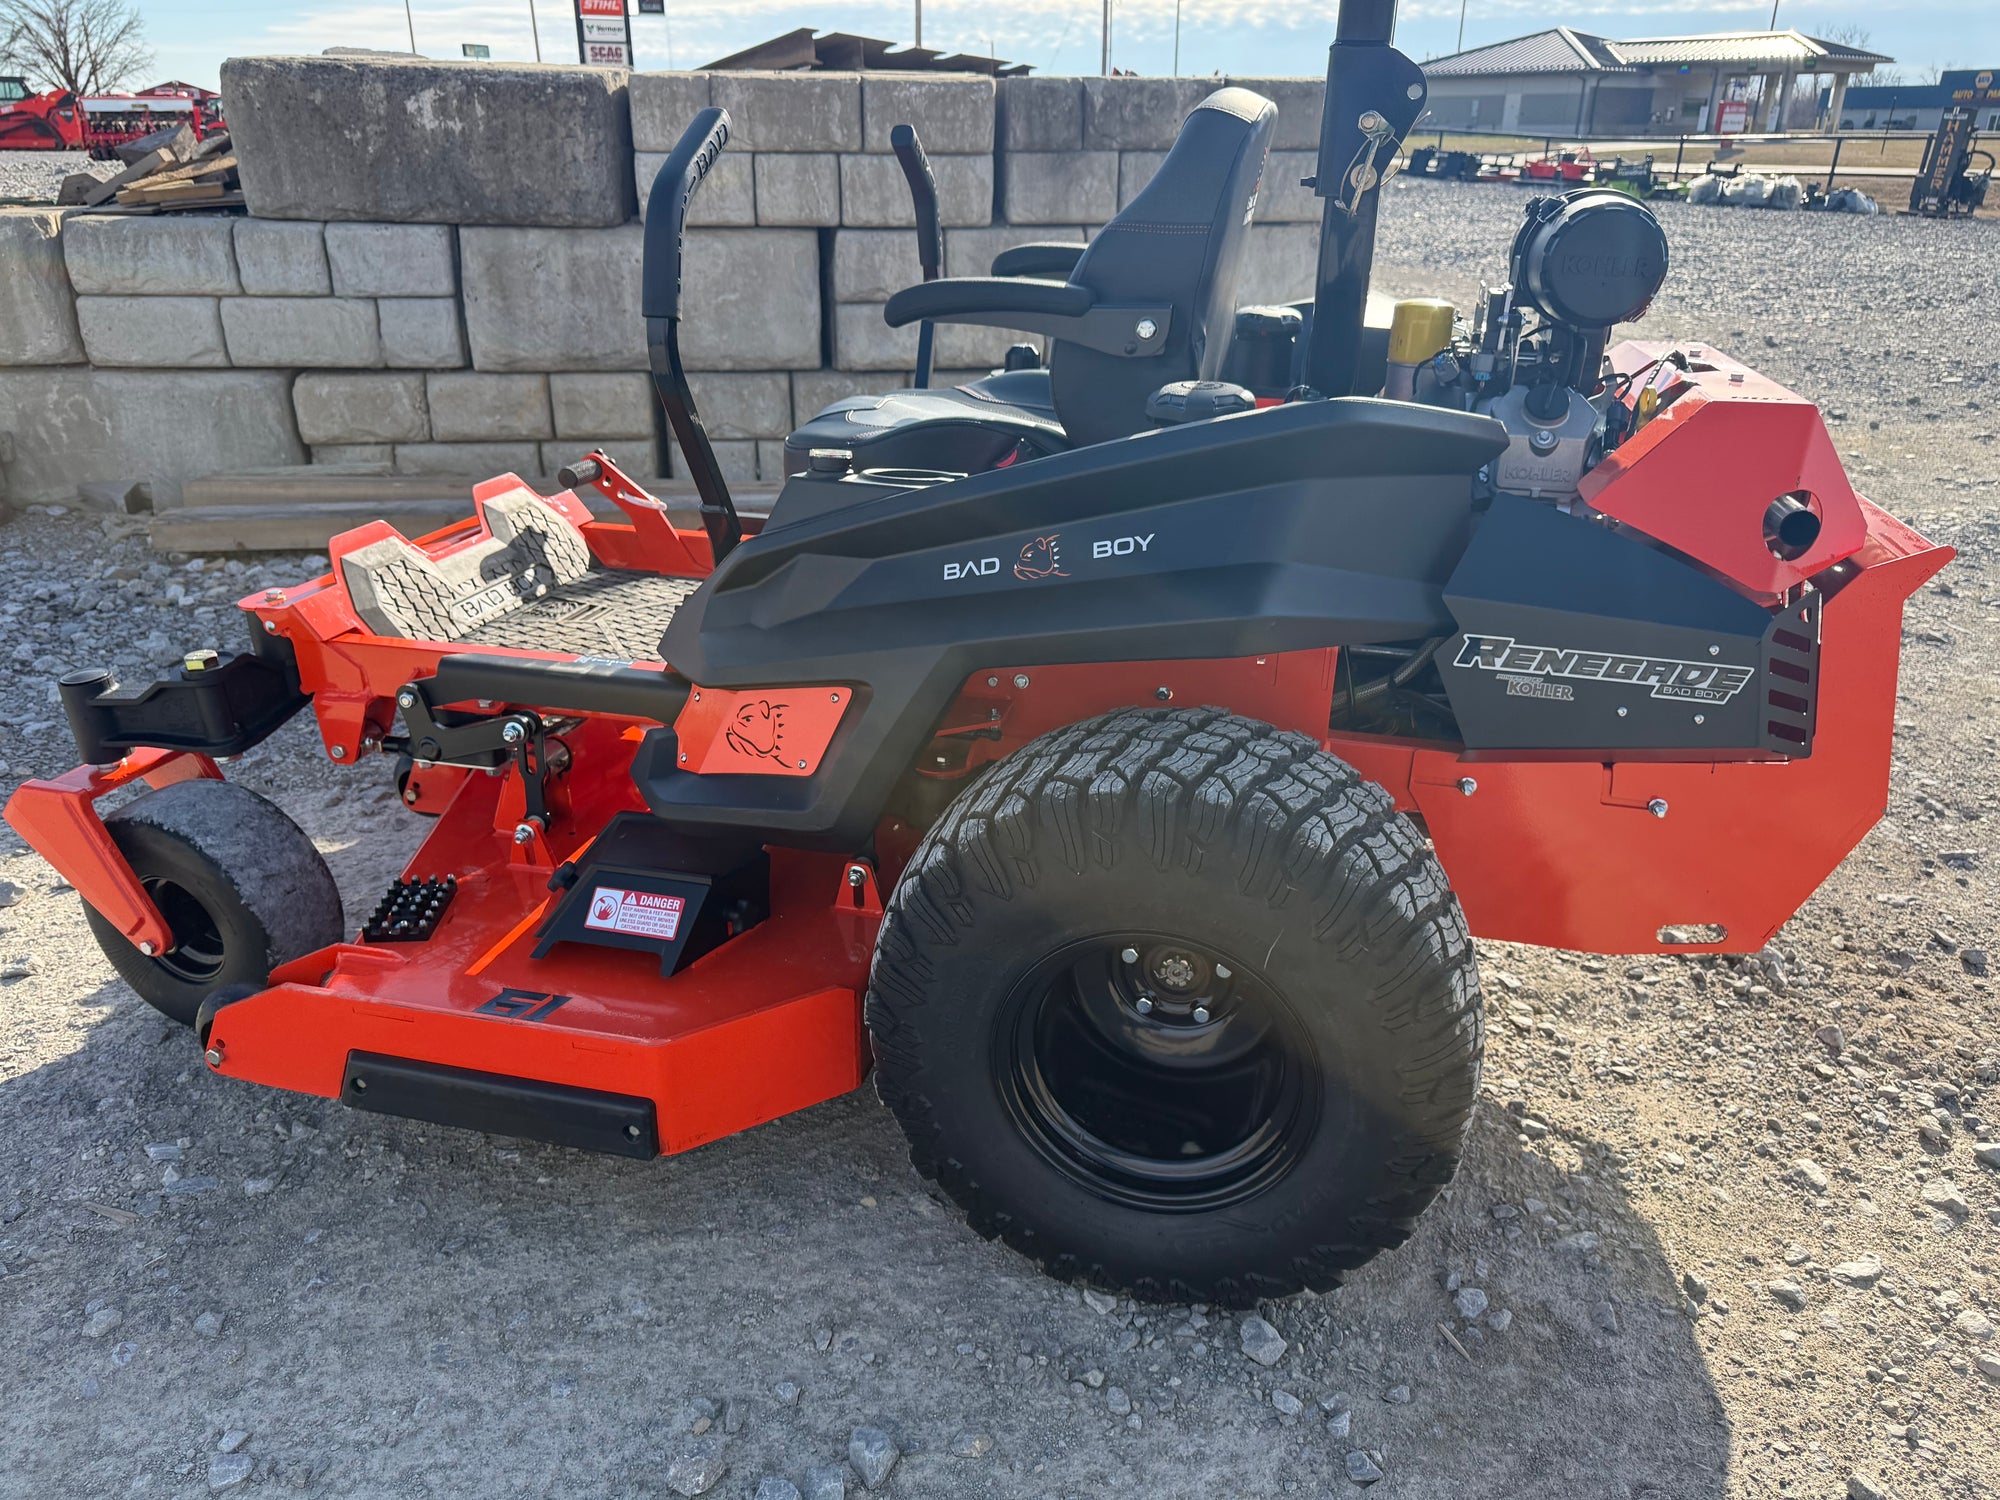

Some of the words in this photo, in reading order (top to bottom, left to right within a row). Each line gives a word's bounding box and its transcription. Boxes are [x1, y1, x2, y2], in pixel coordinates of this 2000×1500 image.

[583, 0, 620, 11] STIHL
[590, 46, 622, 58] SCAG
[1952, 90, 1974, 99] AUTO
[696, 123, 729, 181] BAD
[1930, 120, 1960, 190] HAMMER
[1561, 255, 1649, 277] KOHLER
[1504, 465, 1571, 482] KOHLER
[944, 557, 1000, 580] BAD
[1092, 533, 1155, 559] BOY
[459, 588, 505, 618] BAD
[1663, 686, 1691, 696] BAD
[1695, 690, 1725, 700] BOY
[640, 895, 681, 910] DANGER
[473, 987, 573, 1022] 61
